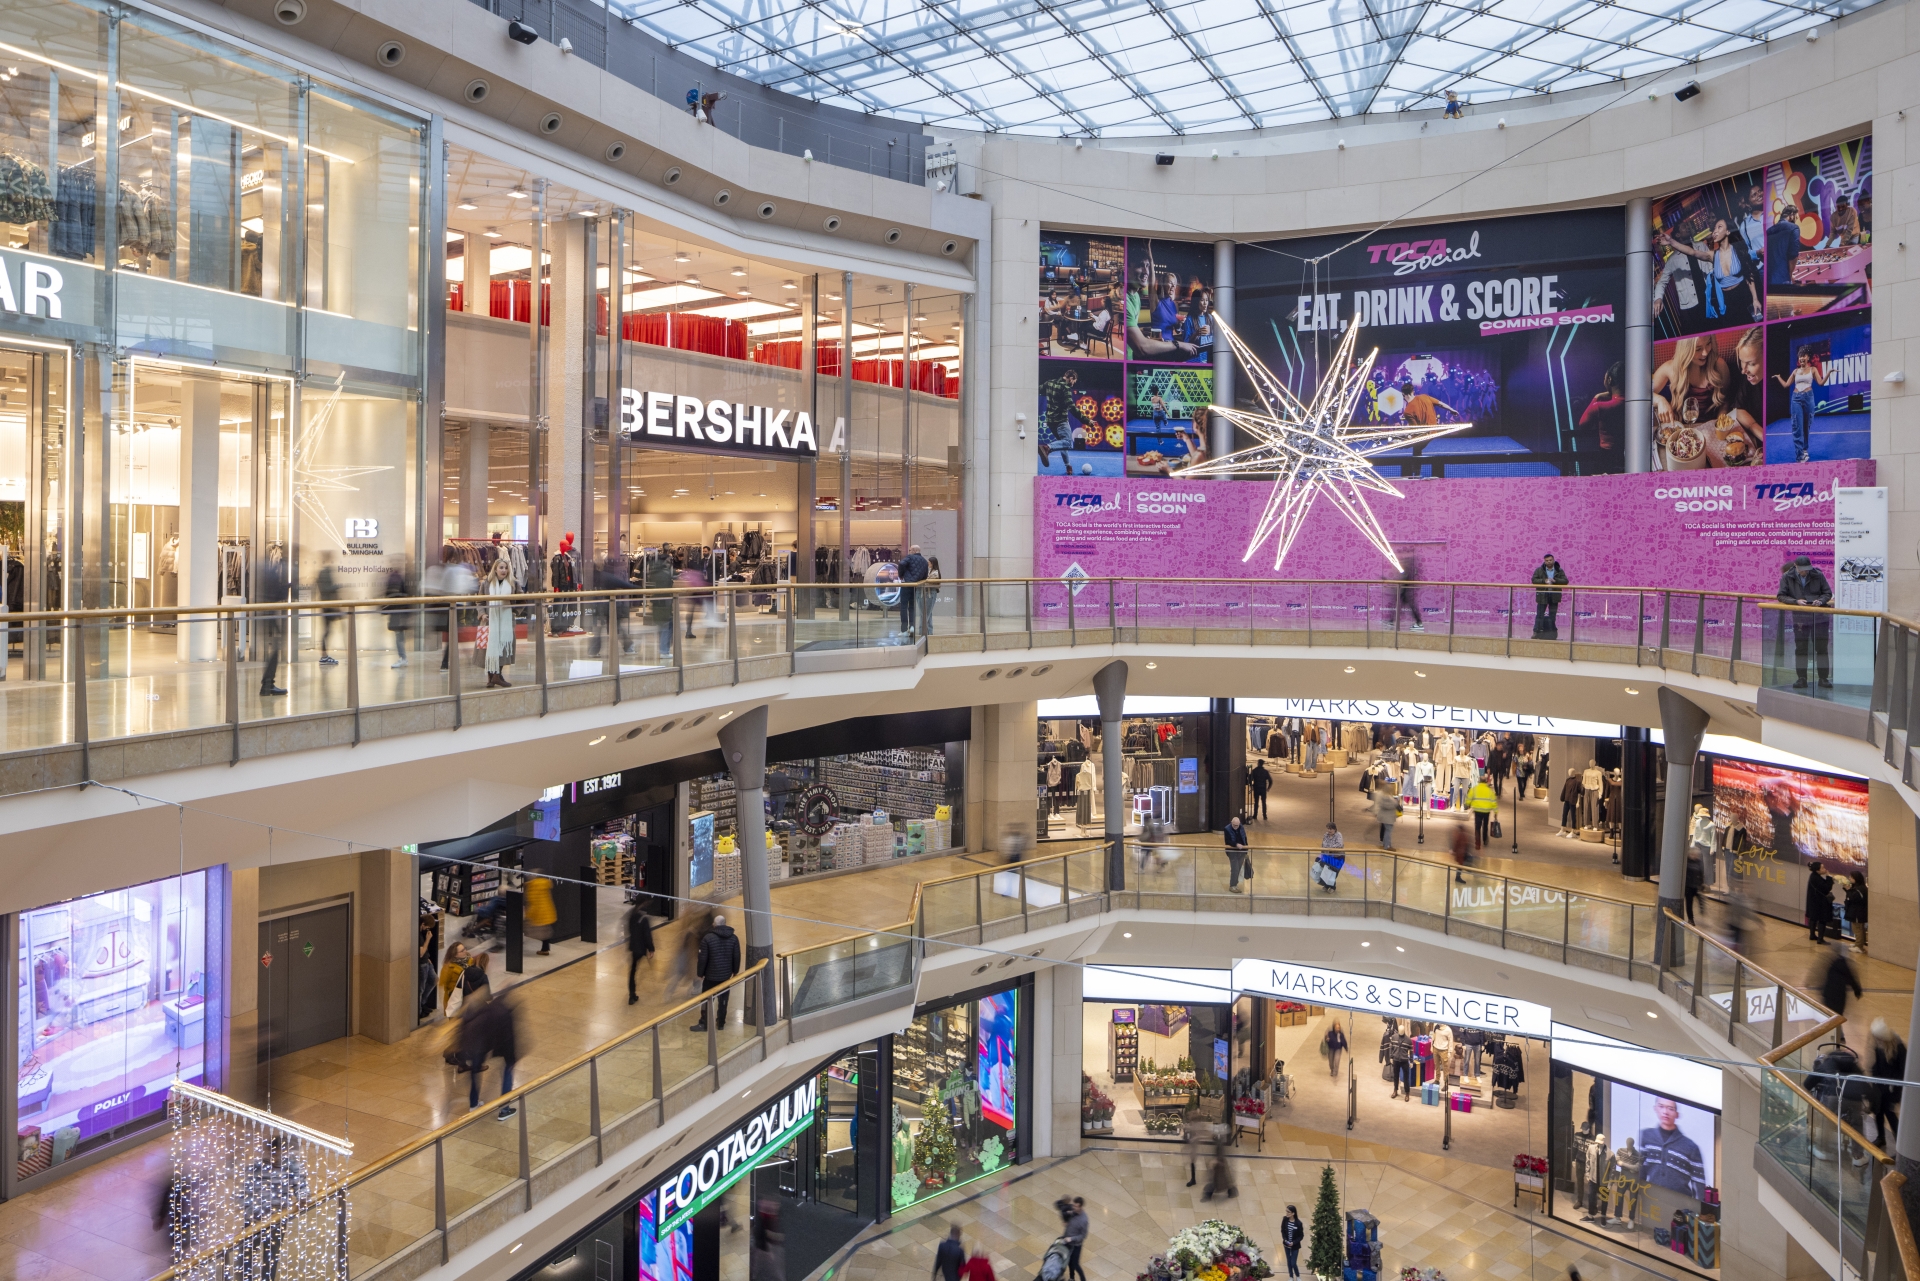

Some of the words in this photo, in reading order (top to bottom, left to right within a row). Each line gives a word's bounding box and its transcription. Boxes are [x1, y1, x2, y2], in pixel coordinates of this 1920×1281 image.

[1366, 238, 1447, 264] TOCA
[1392, 230, 1481, 276] Social
[1298, 292, 1348, 332] EAT,
[1354, 285, 1434, 328] DRINK
[1440, 284, 1461, 323] &
[1467, 275, 1558, 320] SCORE
[1479, 314, 1556, 330] COMING
[1558, 313, 1614, 326] SOON
[620, 387, 817, 450] BERSHKA
[1054, 494, 1102, 506] TOCA
[1136, 492, 1206, 502] COMING
[1654, 485, 1732, 498] COMING
[1754, 482, 1814, 500] TOCA
[1773, 476, 1837, 512] Social
[1070, 492, 1122, 516] Social
[1136, 504, 1187, 514] SOON
[1674, 500, 1732, 512] SOON
[338, 566, 361, 574] Happy
[363, 566, 393, 574] Holidays
[1286, 698, 1380, 716] MARKS
[1387, 700, 1404, 718] &
[892, 754, 910, 763] FAN
[799, 797, 807, 812] THE
[807, 788, 823, 798] HMV
[824, 789, 837, 808] SHOP
[804, 824, 817, 834] EST.
[819, 821, 832, 833] 1921
[1738, 834, 1783, 865] Love
[1734, 859, 1786, 885] STYLE
[1271, 969, 1358, 1000] MARKS
[1366, 984, 1381, 1005] &
[1388, 988, 1520, 1027] SPENCER
[94, 1092, 131, 1114] POLLY
[944, 1084, 970, 1100] GIVING
[659, 1076, 816, 1225] FOOTASYLUM
[1602, 1161, 1659, 1200] Love
[1598, 1186, 1661, 1222] STYLE
